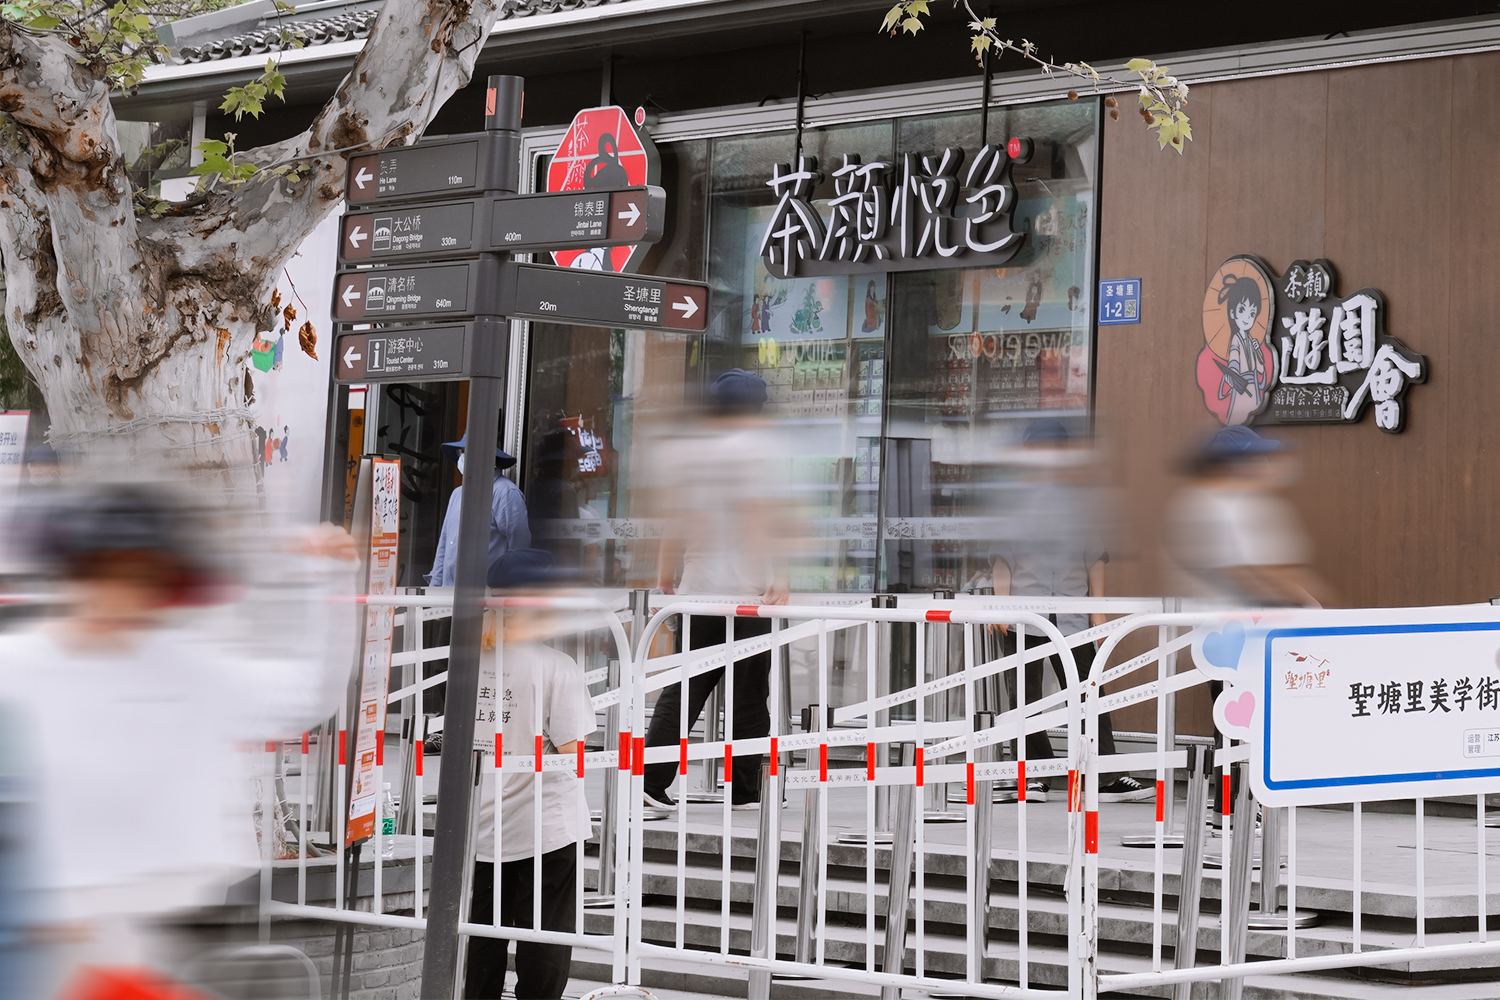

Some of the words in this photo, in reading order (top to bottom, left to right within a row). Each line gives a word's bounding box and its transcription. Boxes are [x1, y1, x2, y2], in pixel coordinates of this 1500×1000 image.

[448, 175, 462, 185] 110m
[574, 200, 605, 218] 锦泰里
[393, 215, 421, 233] 大公桥
[590, 220, 602, 228] Lane
[409, 234, 423, 243] Bridge
[441, 237, 457, 246] 330m
[505, 232, 521, 241] 400m
[387, 276, 416, 293] 清名桥
[407, 294, 421, 303] Bridge
[622, 285, 662, 304] 圣塘里
[435, 299, 452, 308] 640m
[539, 301, 557, 312] 20m
[624, 304, 659, 314] Shengtangli
[1104, 302, 1123, 318] 1-2
[387, 337, 424, 354] 游客中心
[433, 360, 448, 369] 310m
